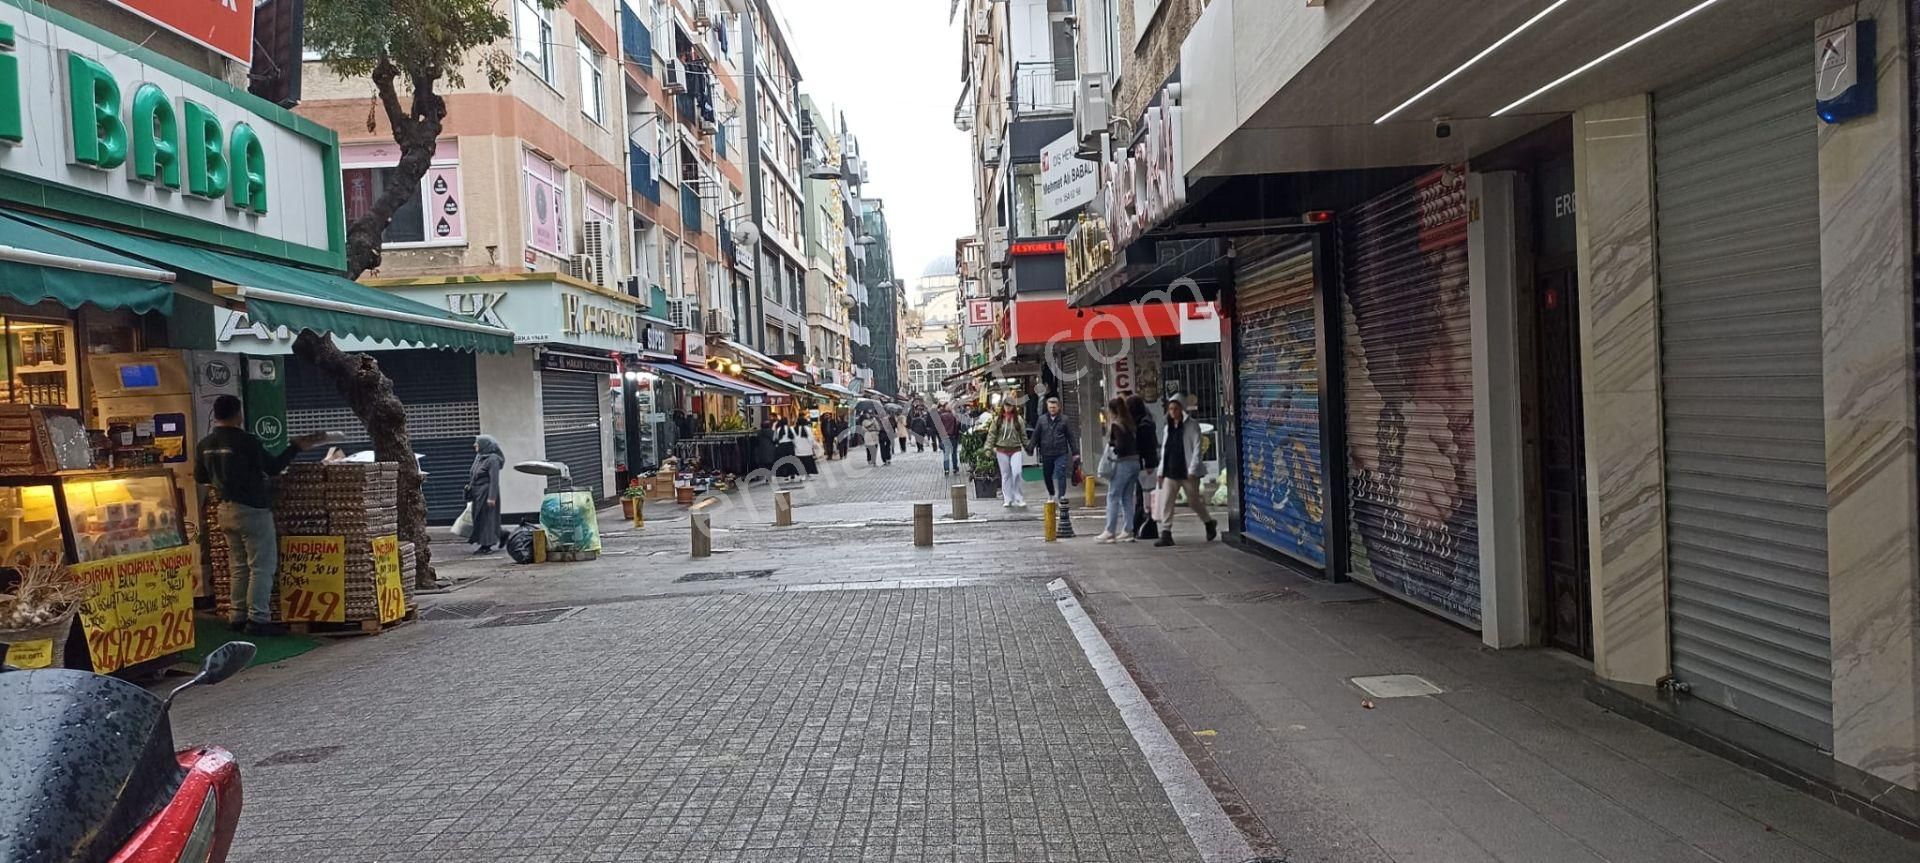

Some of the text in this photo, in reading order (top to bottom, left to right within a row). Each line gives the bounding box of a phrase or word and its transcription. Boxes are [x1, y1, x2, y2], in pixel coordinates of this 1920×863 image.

[68, 50, 268, 216] BABA
[583, 304, 637, 340] HAKAN
[976, 303, 988, 320] E
[287, 541, 339, 553] İNDİRİM
[285, 589, 340, 621] 149
[381, 586, 401, 620] 149
[160, 607, 193, 650] 269
